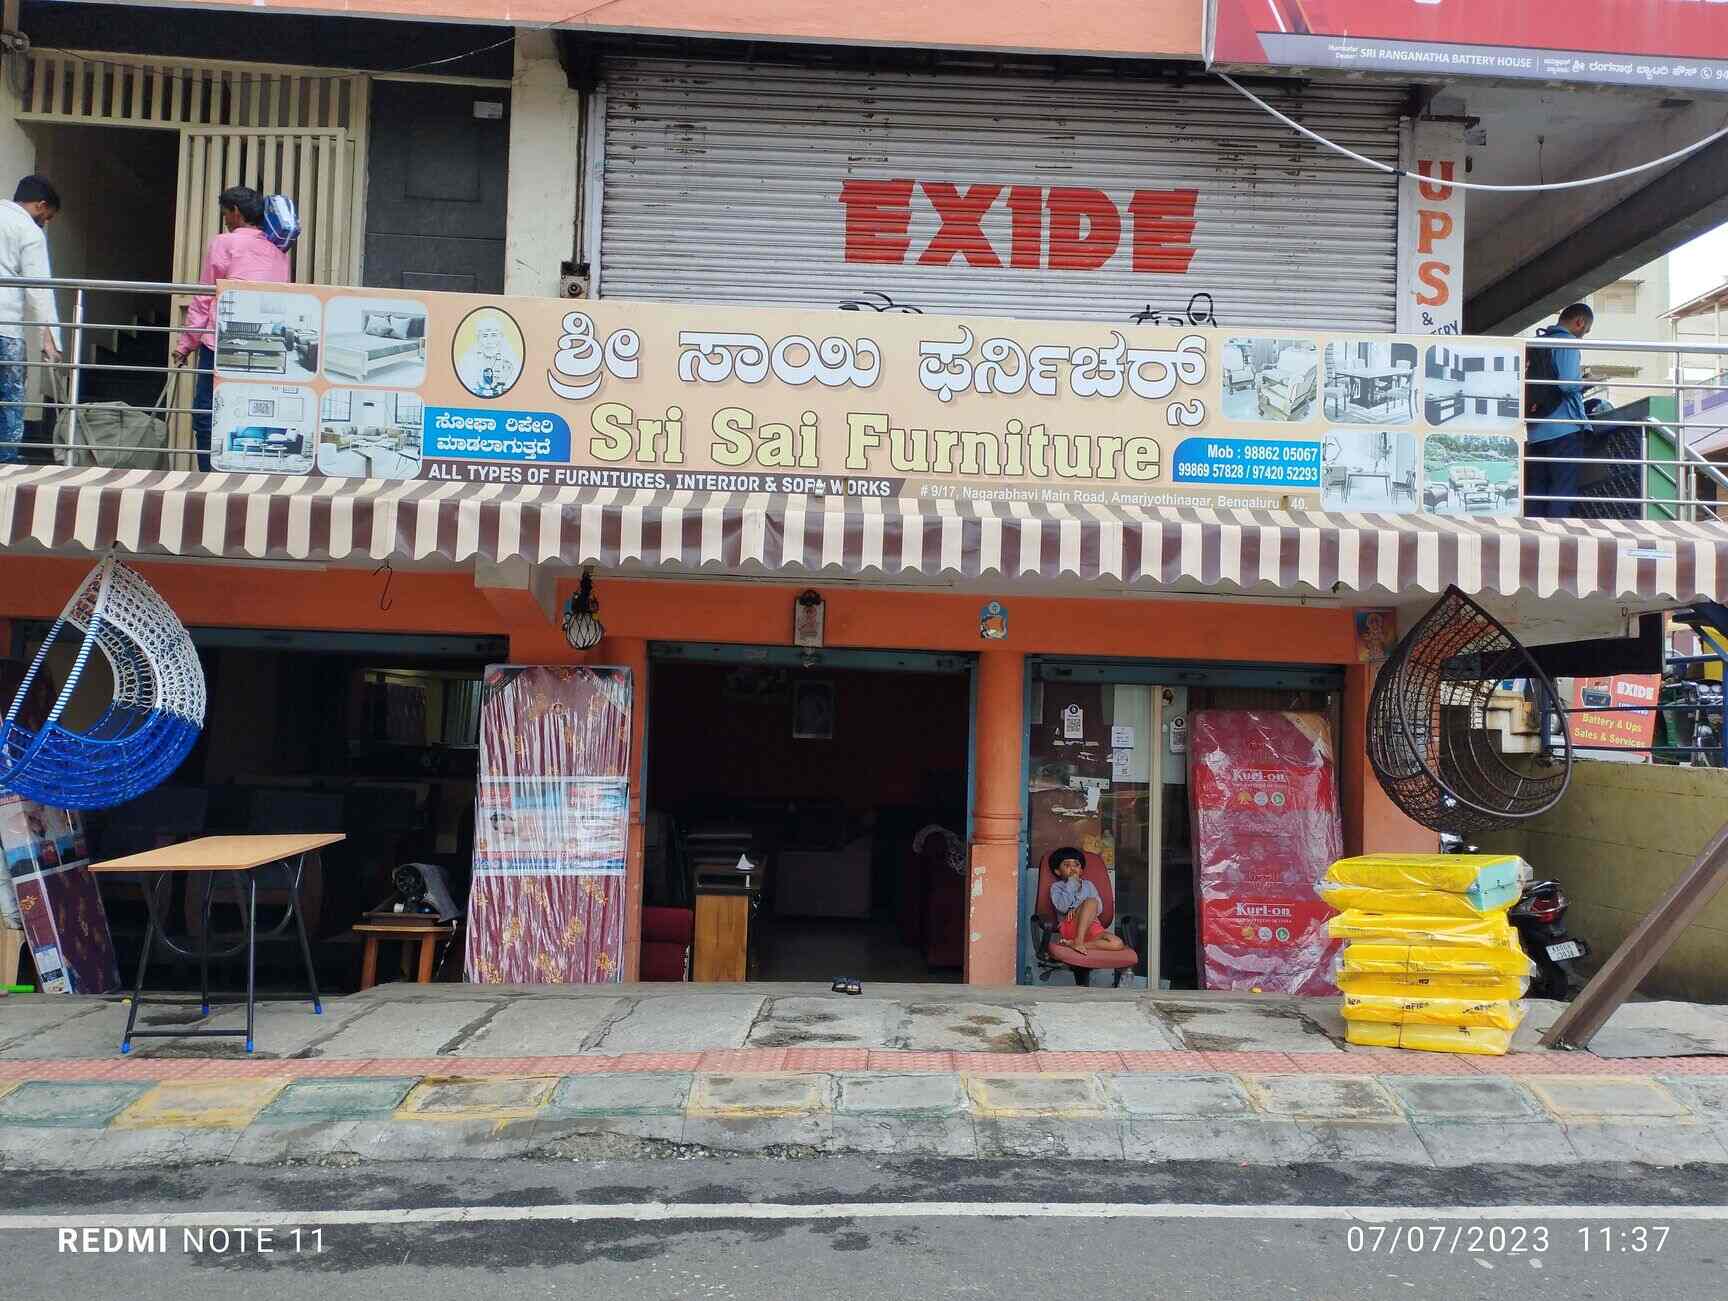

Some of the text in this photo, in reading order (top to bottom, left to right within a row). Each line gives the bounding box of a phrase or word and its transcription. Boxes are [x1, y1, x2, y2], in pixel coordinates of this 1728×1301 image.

[1359, 48, 1376, 58] SRI
[1379, 50, 1449, 63] RANGANATHA
[1451, 54, 1495, 65] BATTERY
[1497, 57, 1532, 68] HOUSE
[838, 178, 1200, 273] EXIDE
[1421, 312, 1433, 326] &
[547, 311, 640, 400] ಶ್ರೀ
[679, 330, 881, 388] ಸಾಯಿ
[590, 402, 1161, 481] Sri Sai Furniture
[1207, 444, 1233, 459] Mob
[1244, 445, 1280, 461] 98862
[1283, 447, 1318, 461] 05067
[428, 463, 462, 480] ALL
[467, 465, 522, 482] TYPES
[527, 468, 550, 483] OF
[555, 469, 670, 490] FURNITURES,
[676, 473, 759, 492] INTERIOR
[765, 477, 777, 491] &
[831, 479, 891, 496] WORKS
[1178, 462, 1210, 477] 99869
[1212, 464, 1243, 478] 57828
[1252, 465, 1283, 480] 97420
[1286, 467, 1318, 481] 52293
[920, 485, 928, 497] #
[931, 486, 960, 499] 9/17,
[962, 487, 1038, 502] Nagarabhavi
[1041, 489, 1070, 502] Main
[1074, 490, 1107, 503] Road,
[1217, 495, 1280, 511] Bengaluru
[1583, 713, 1615, 729] Battery
[1574, 727, 1600, 740] Sales
